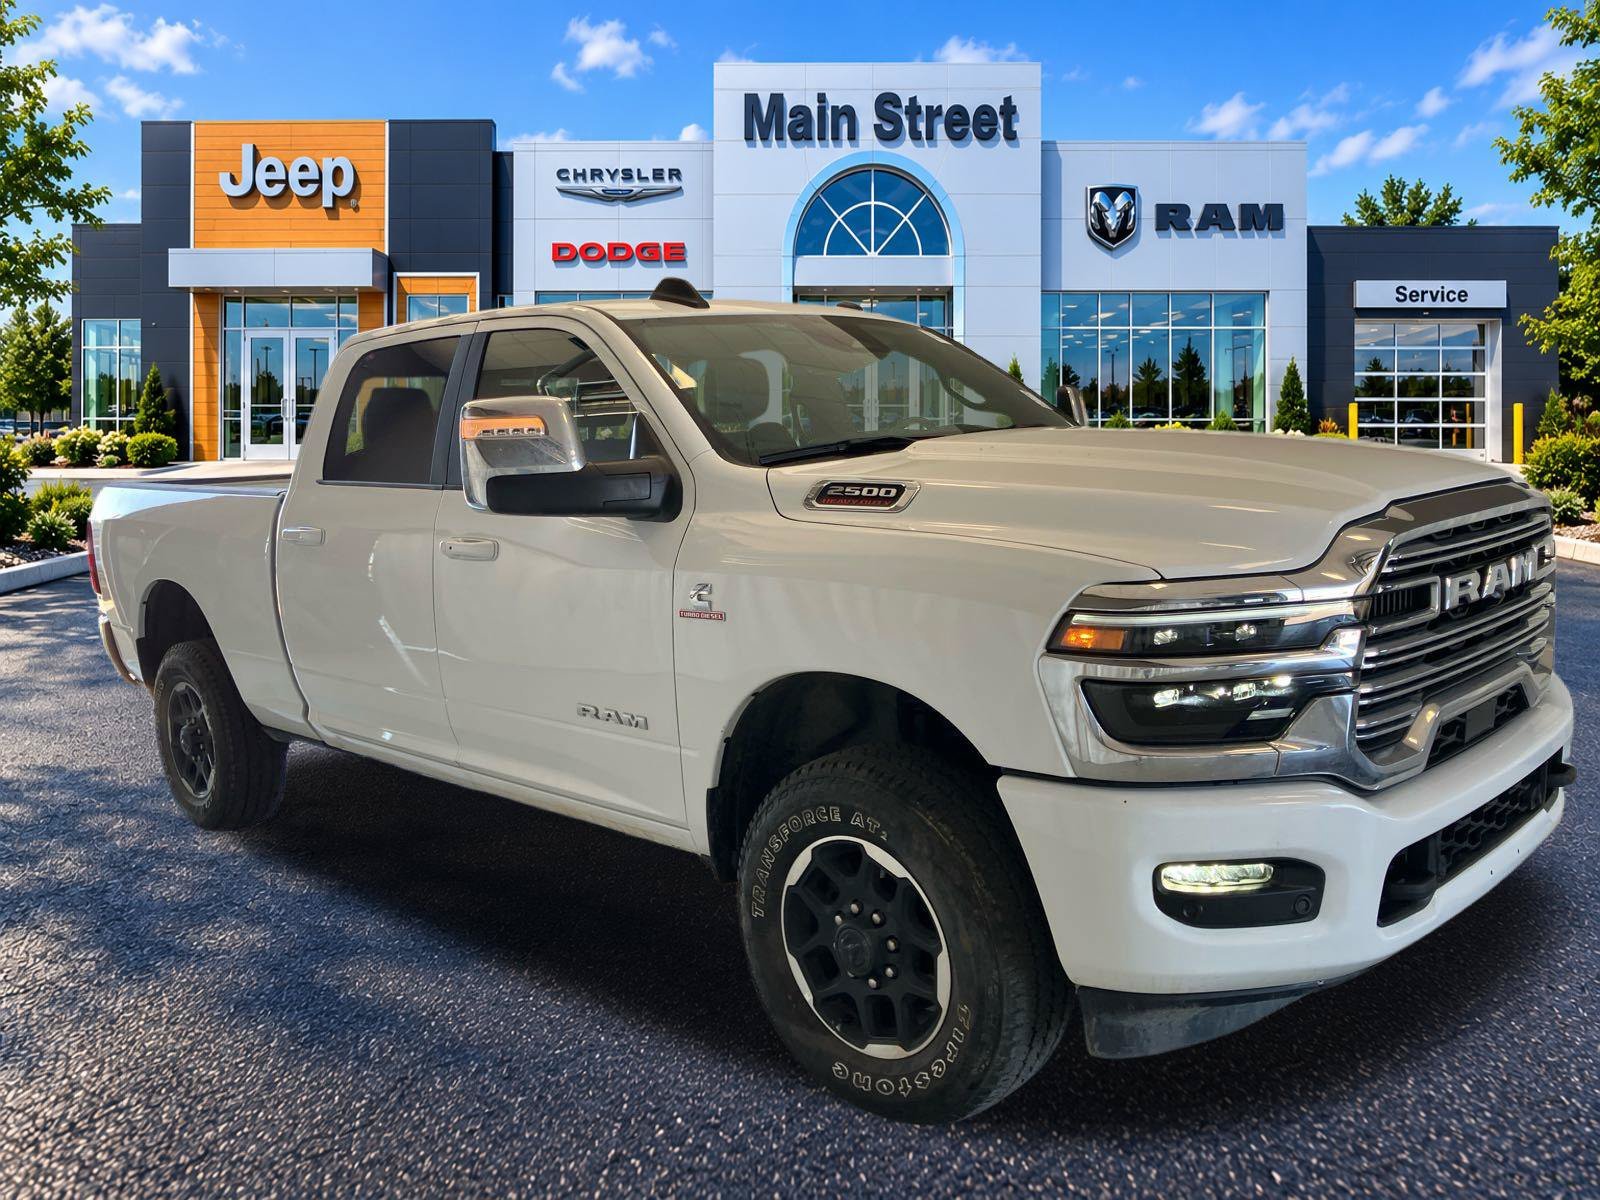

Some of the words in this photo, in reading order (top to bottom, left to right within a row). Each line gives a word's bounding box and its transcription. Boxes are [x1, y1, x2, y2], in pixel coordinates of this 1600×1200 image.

[743, 92, 858, 142] Main
[873, 91, 1018, 142] Street
[218, 143, 356, 209] Jeep
[556, 168, 682, 183] CHRYSLER
[1155, 203, 1284, 233] RAM
[551, 241, 686, 264] DODGE
[1395, 285, 1469, 303] Service
[826, 485, 898, 498] 2500
[1445, 546, 1540, 610] RAM
[680, 610, 700, 619] TURBO
[700, 612, 724, 621] DIESEL
[577, 702, 649, 730] RAM
[751, 806, 842, 919] TRANSFORCE
[832, 1003, 972, 1098] Firestone
